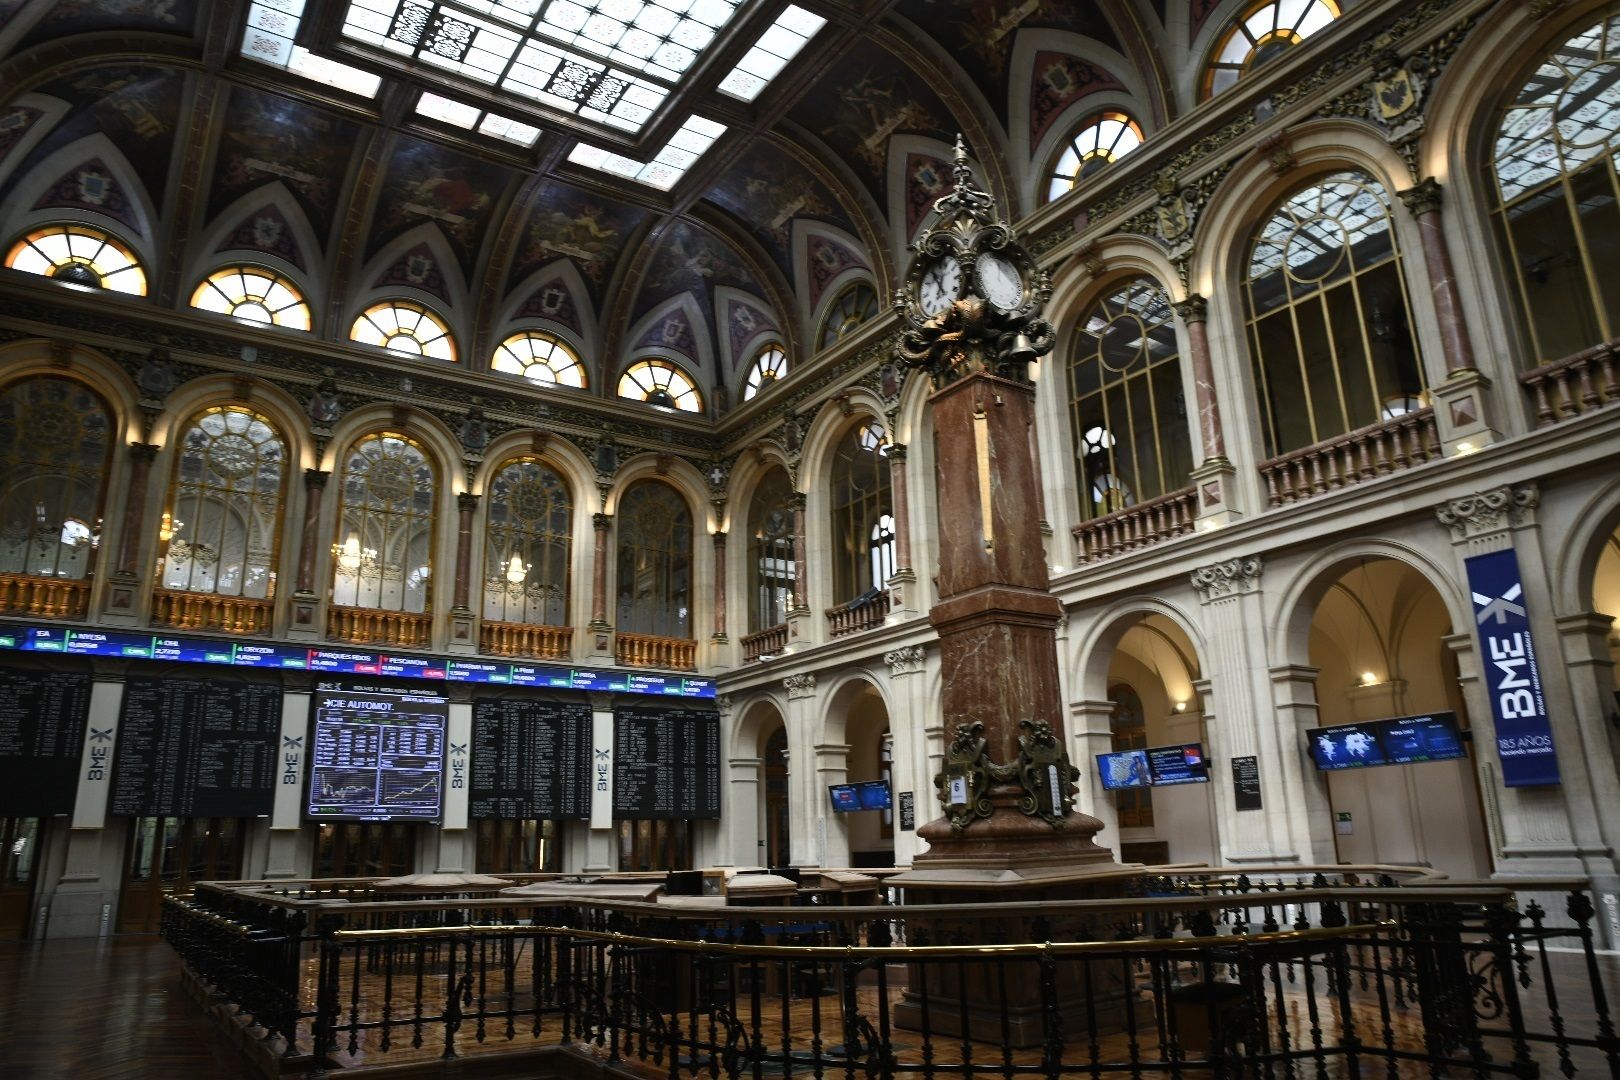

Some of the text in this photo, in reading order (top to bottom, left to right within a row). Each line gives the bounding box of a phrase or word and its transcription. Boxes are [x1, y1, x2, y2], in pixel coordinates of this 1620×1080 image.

[1488, 632, 1536, 720] BME
[331, 699, 346, 708] CIE
[347, 700, 395, 711] AUTOMOT.
[1517, 735, 1552, 748] AÑOS
[88, 745, 106, 780] BME
[283, 752, 299, 785] BME
[451, 758, 464, 789] BME
[597, 763, 608, 791] BME
[954, 782, 960, 792] 6
